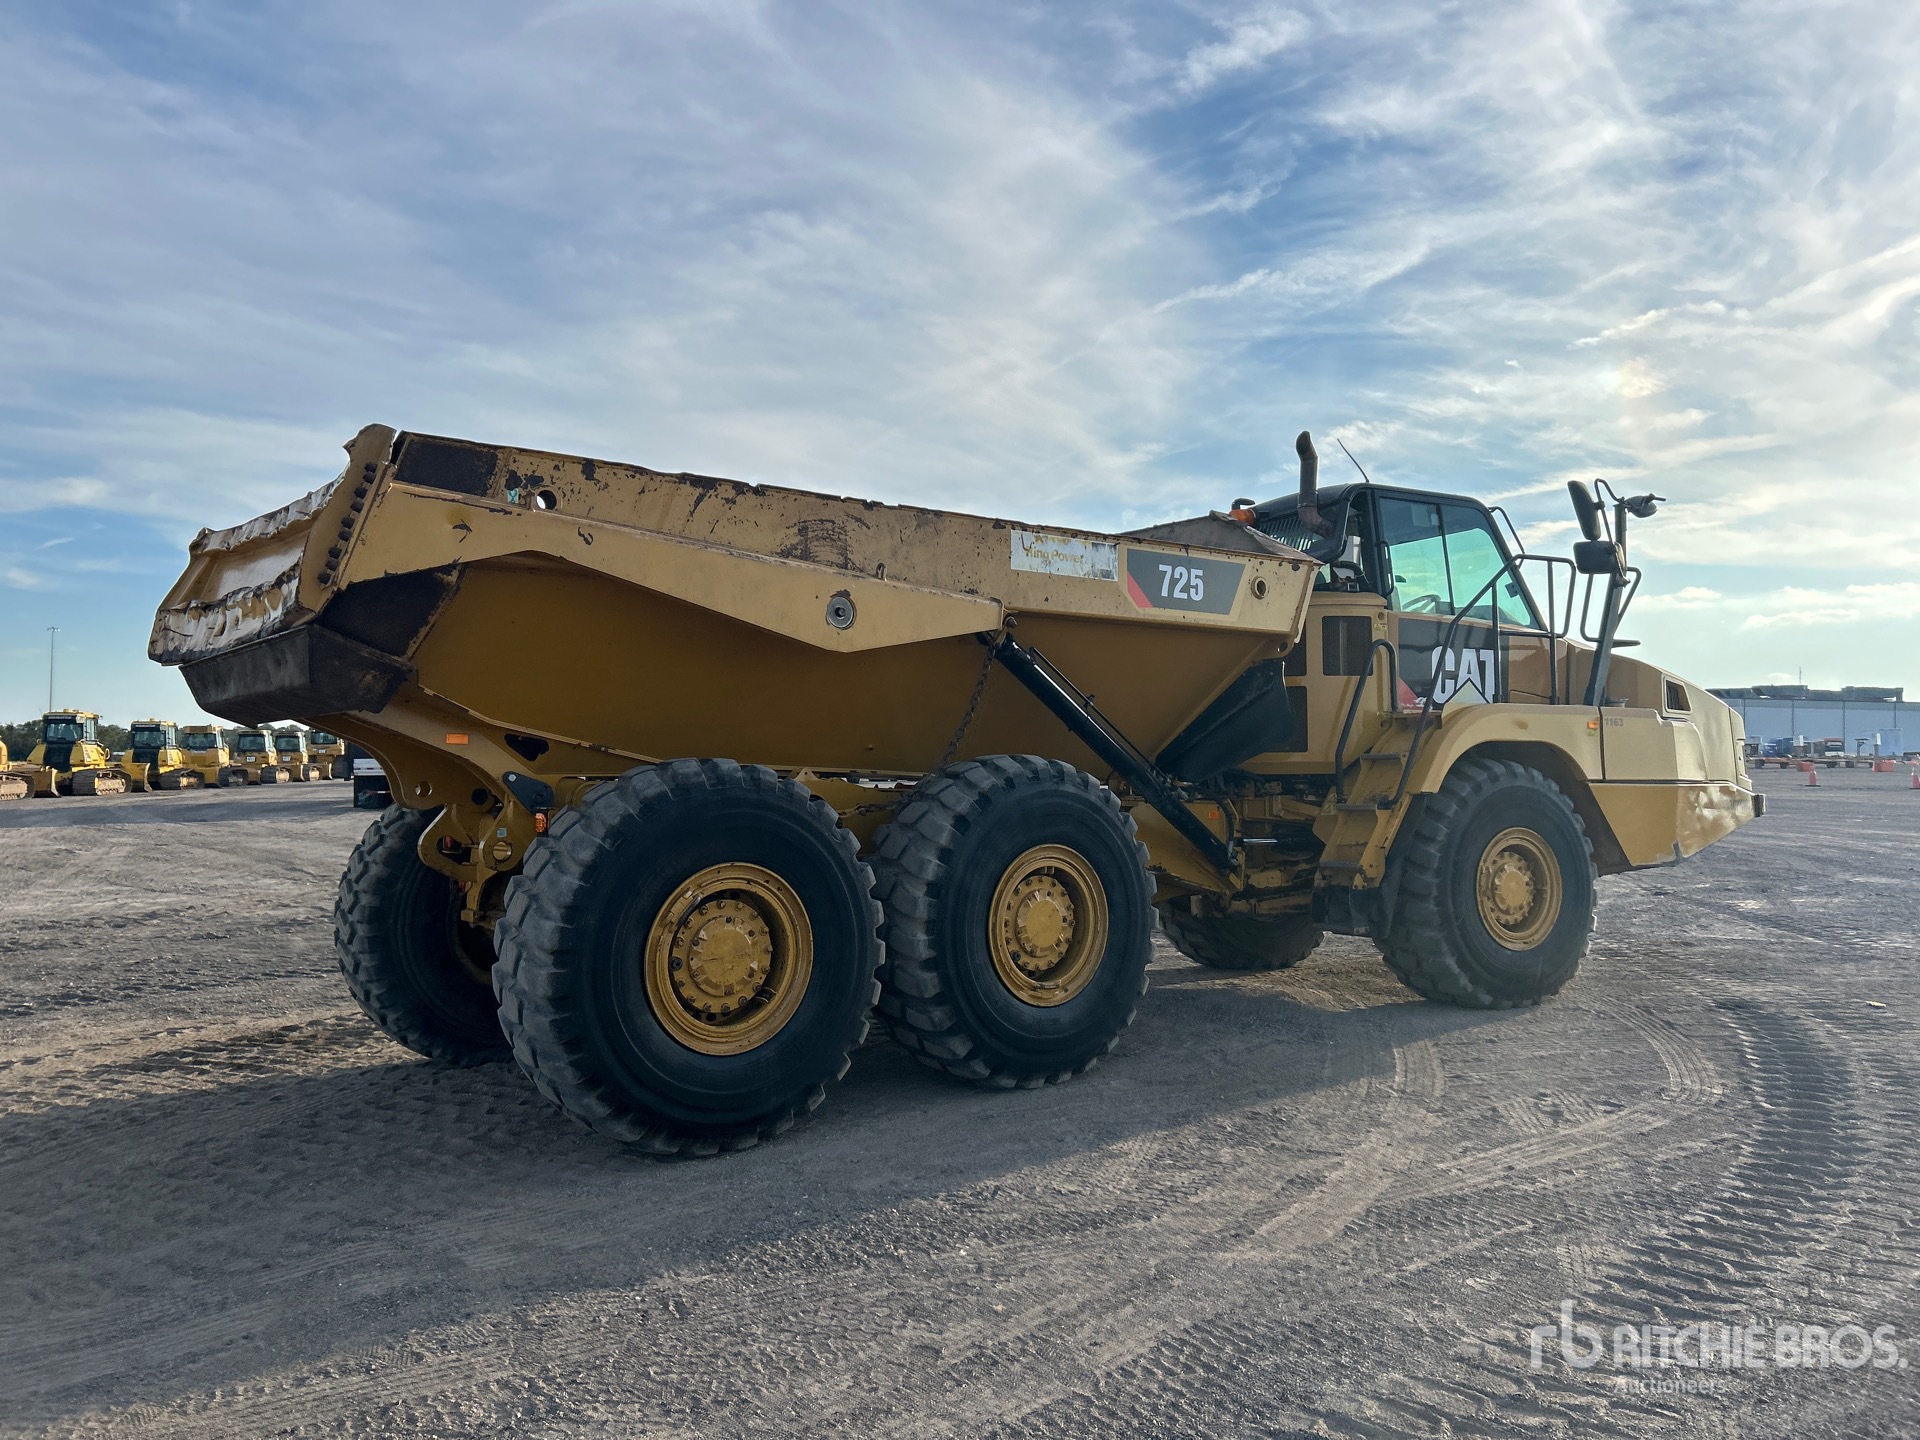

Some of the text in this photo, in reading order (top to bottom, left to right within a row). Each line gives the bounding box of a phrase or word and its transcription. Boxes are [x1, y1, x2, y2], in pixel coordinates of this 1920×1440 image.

[1158, 564, 1204, 602] 725
[1431, 646, 1501, 704] CAT
[1604, 717, 1624, 727] 1163
